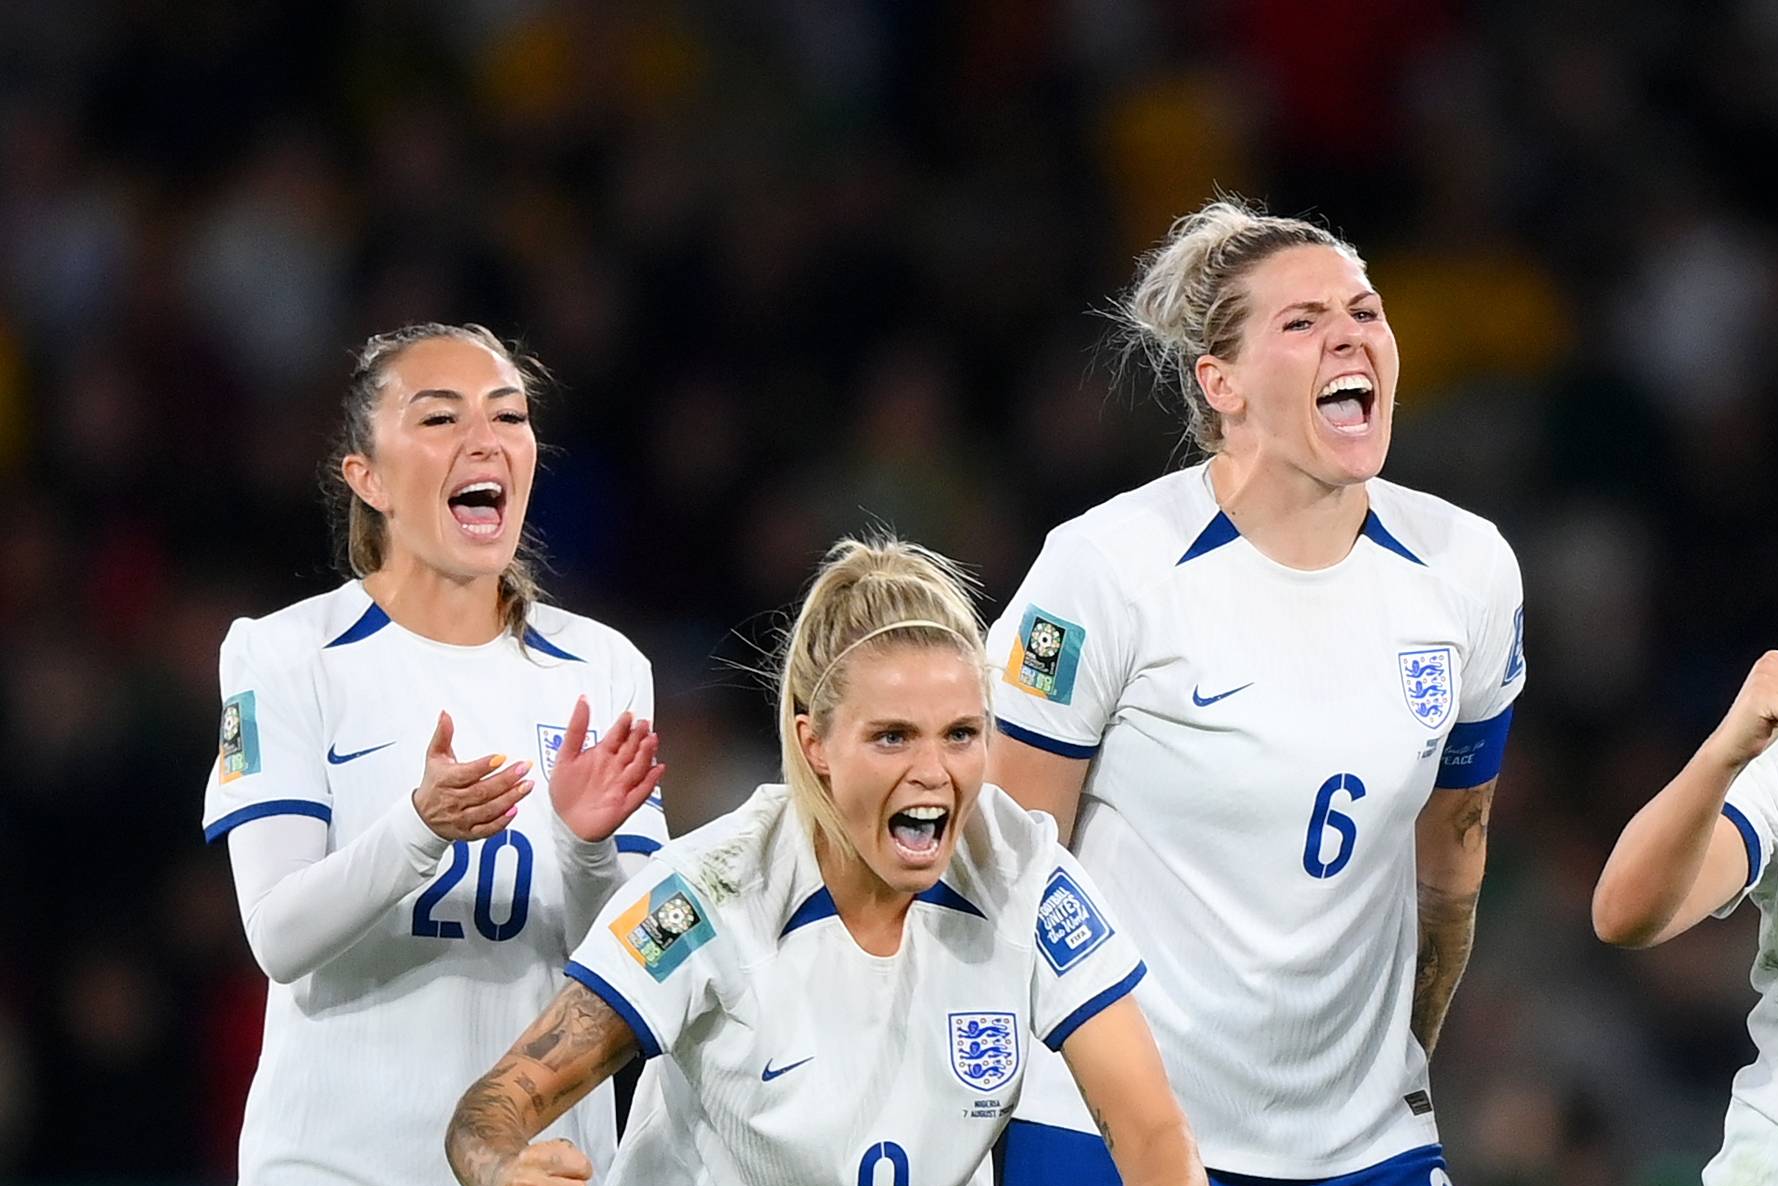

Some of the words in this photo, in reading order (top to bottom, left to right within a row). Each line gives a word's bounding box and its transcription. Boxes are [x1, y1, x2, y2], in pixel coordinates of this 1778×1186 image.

[1441, 753, 1475, 765] EACE
[1303, 773, 1366, 880] 6
[412, 828, 534, 942] 20
[1043, 894, 1081, 930] UNITES
[962, 1109, 969, 1118] 7
